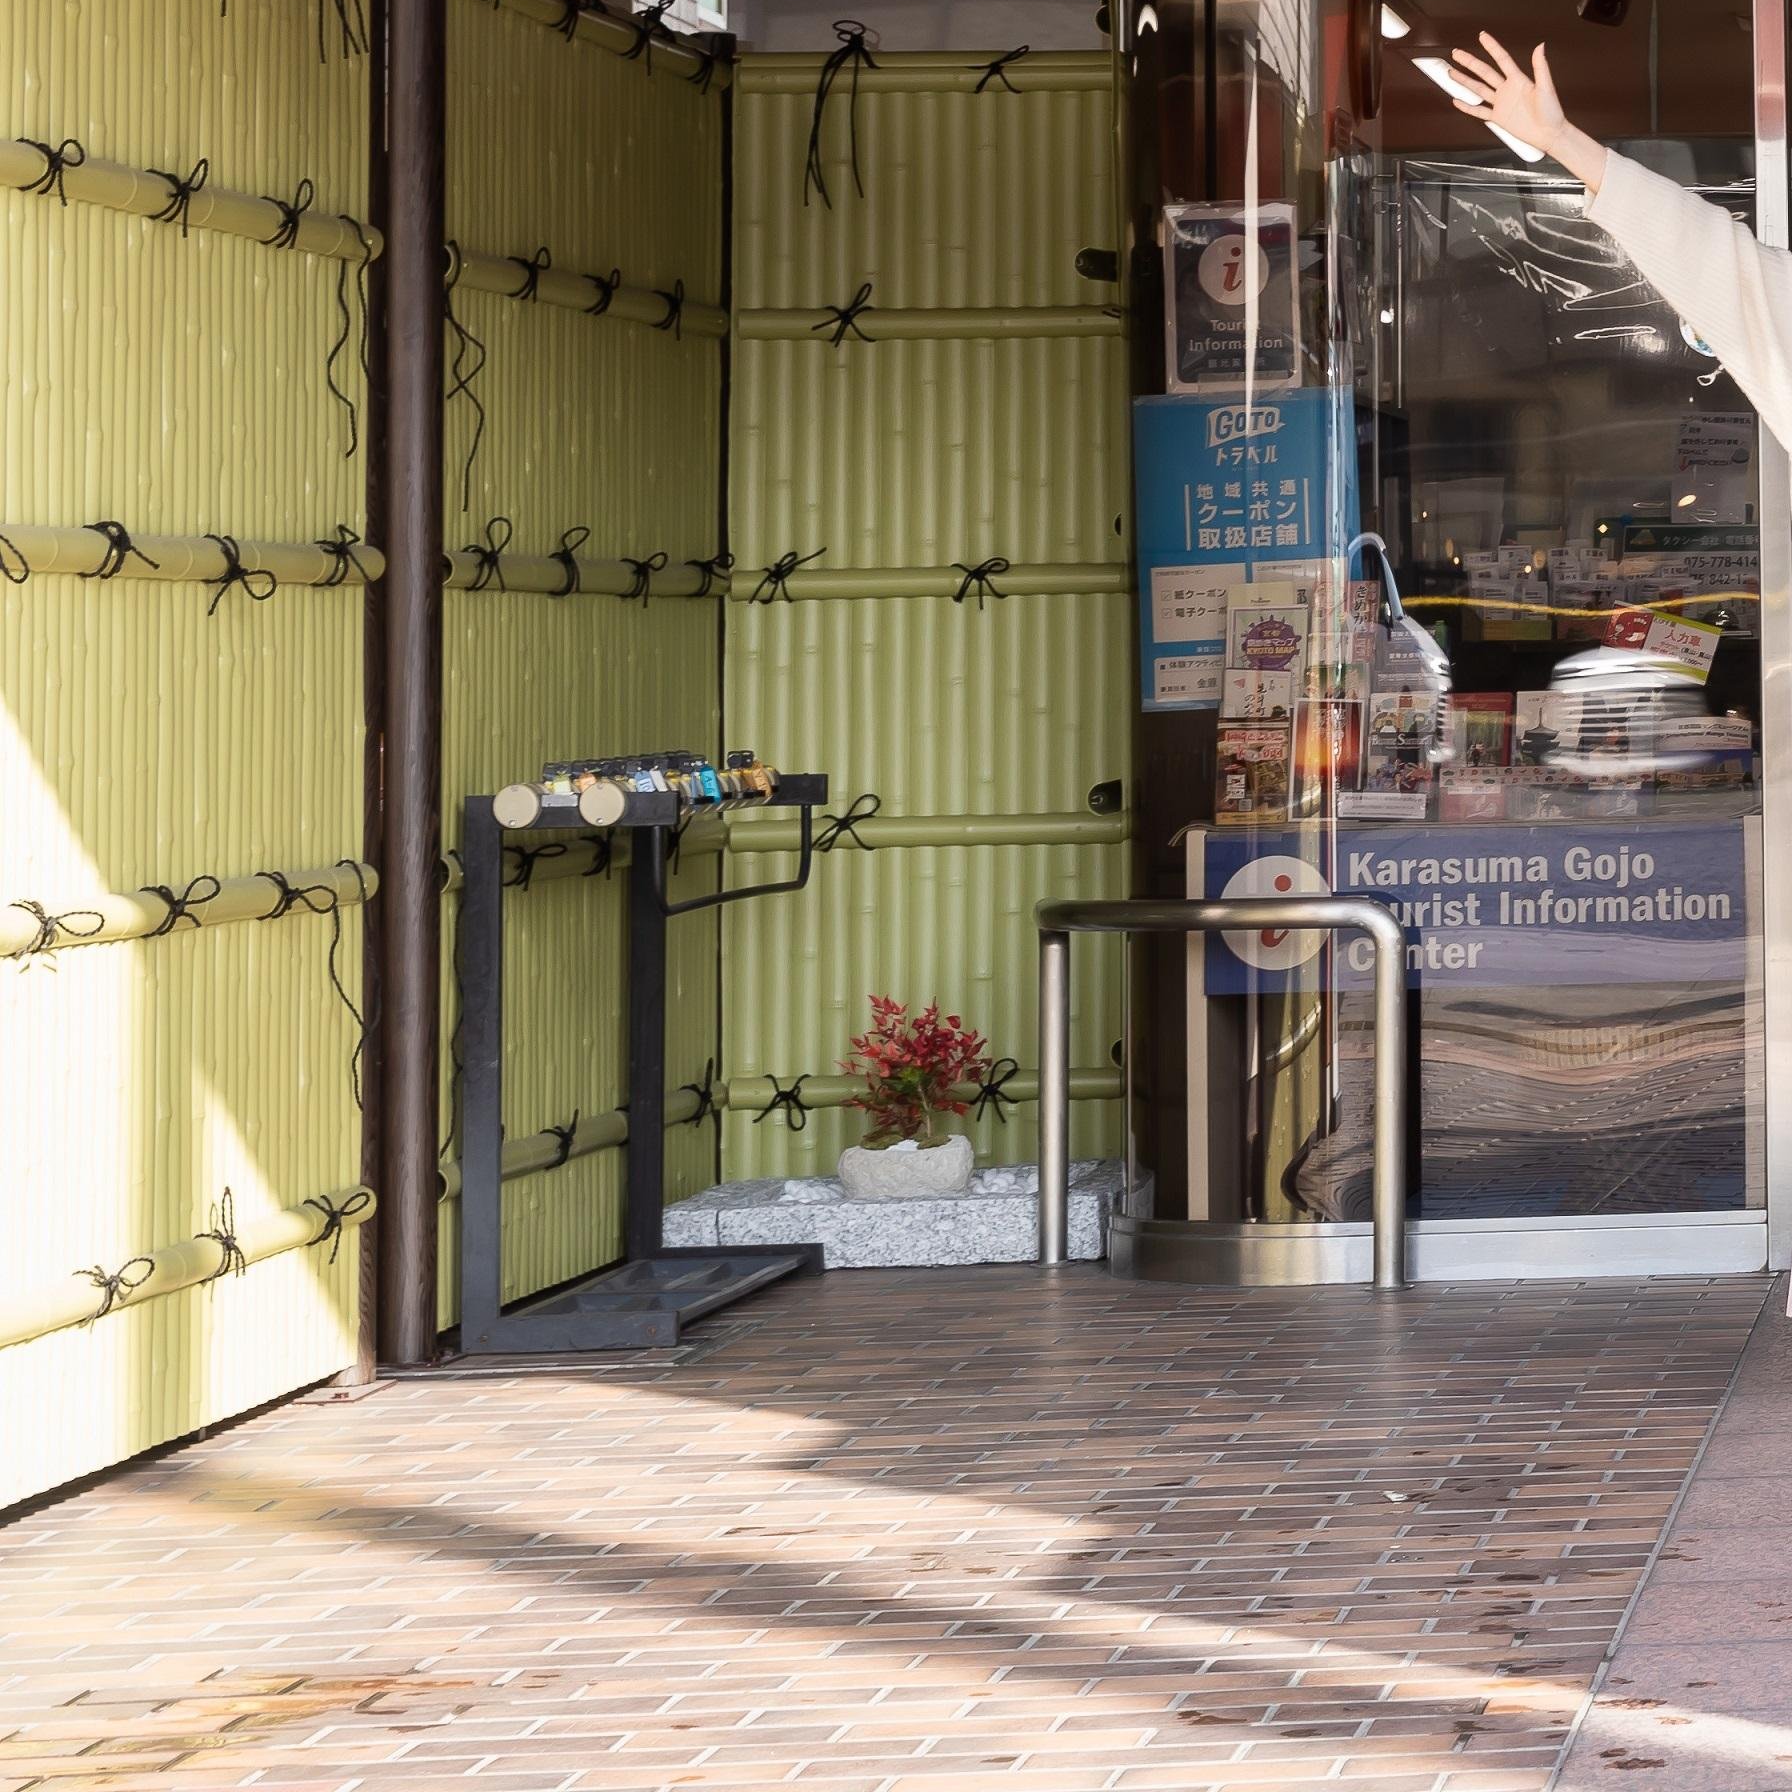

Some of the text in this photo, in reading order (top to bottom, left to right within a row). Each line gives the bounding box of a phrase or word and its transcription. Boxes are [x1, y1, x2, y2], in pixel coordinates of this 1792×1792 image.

[1210, 319, 1261, 332] Touri
[1215, 444, 1279, 467] トラベル
[1196, 479, 1298, 500] 地域共通
[1197, 499, 1298, 525] クーポン
[1197, 523, 1299, 550] 取扱店舗
[1348, 845, 1656, 889] Karasuma Gojo
[1350, 886, 1731, 928] urist Information
[1346, 936, 1484, 972] Cnter
